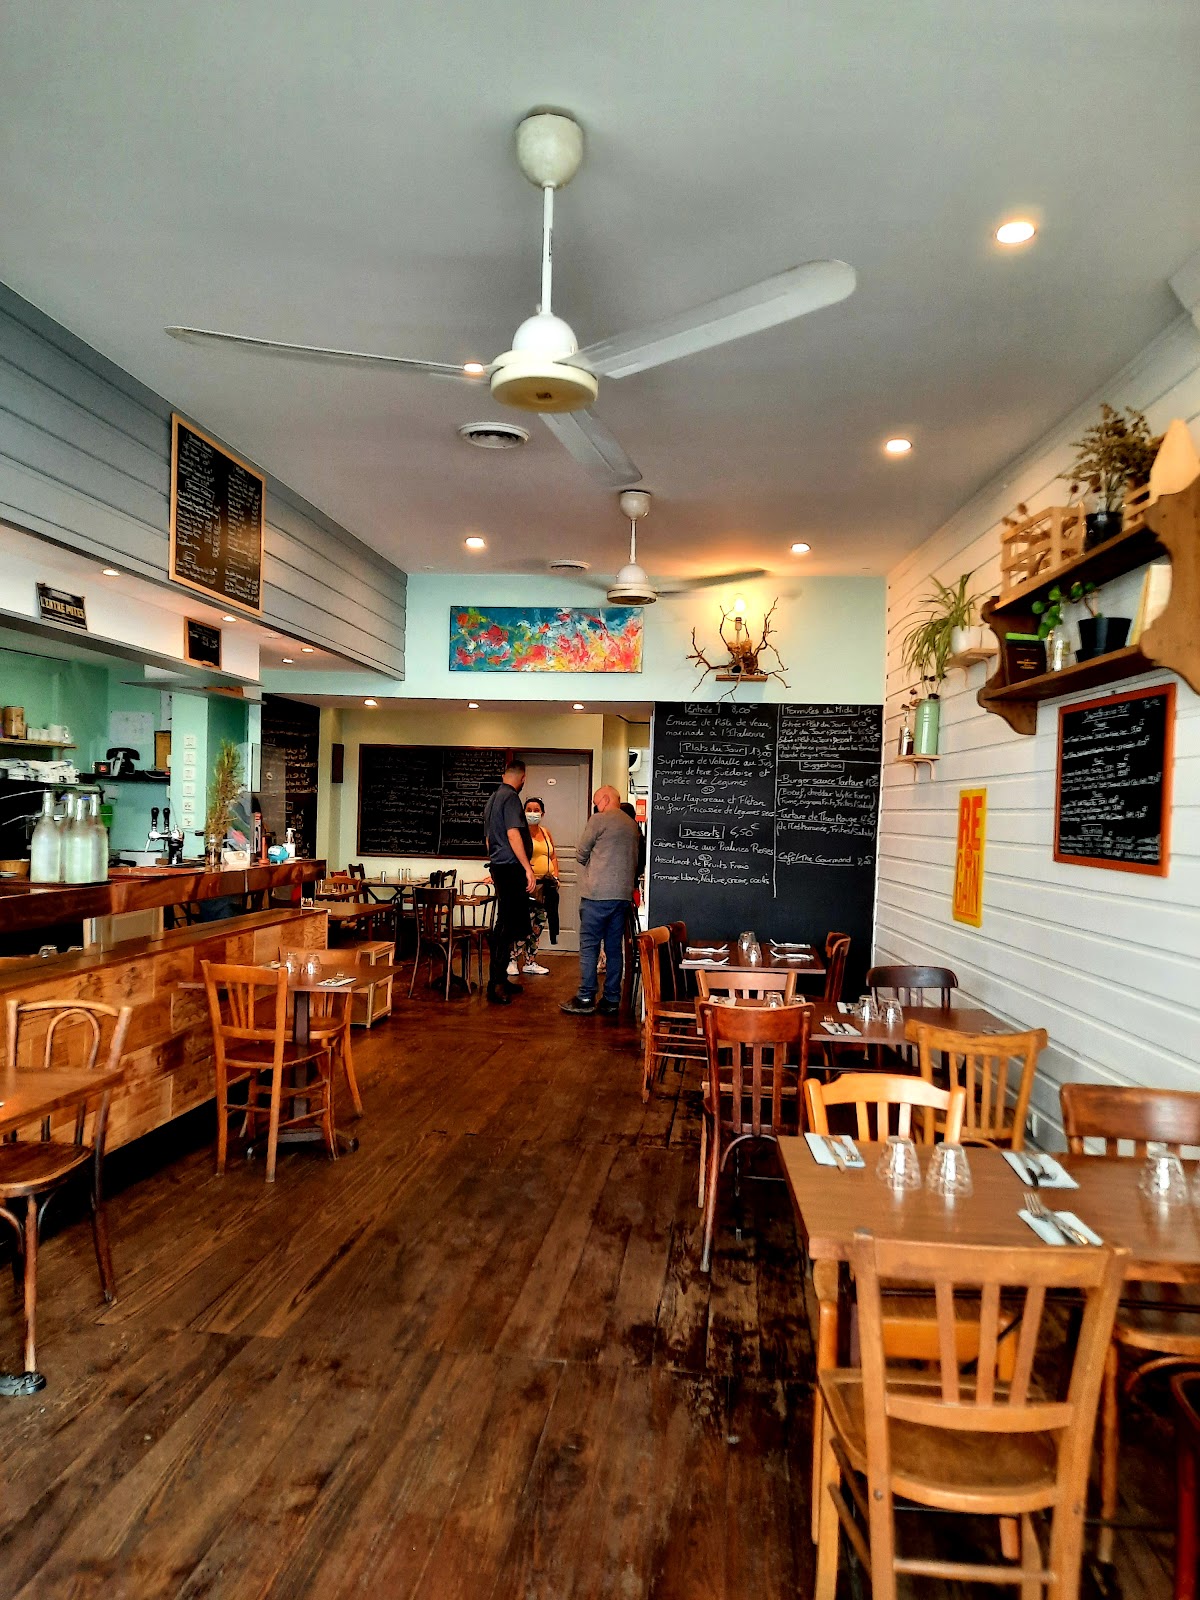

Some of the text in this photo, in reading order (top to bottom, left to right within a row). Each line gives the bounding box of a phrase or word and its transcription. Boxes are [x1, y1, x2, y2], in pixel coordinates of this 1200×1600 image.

[687, 704, 713, 714] Entrée
[785, 705, 819, 715] Formules
[835, 705, 853, 714] Midi
[700, 718, 710, 726] de
[736, 718, 746, 726] de
[666, 728, 704, 736] marinade
[709, 727, 717, 736] à
[682, 743, 708, 752] Plats
[710, 744, 722, 752] du
[722, 744, 745, 753] Jour
[657, 754, 694, 767] Suprême
[697, 756, 707, 765] de
[686, 767, 695, 775] de
[759, 768, 770, 777] et
[696, 777, 707, 785] de
[781, 774, 811, 787] Burger
[836, 775, 864, 786] Tartare
[654, 793, 670, 801] Duo
[671, 794, 681, 802] de
[727, 794, 737, 804] et
[654, 803, 665, 811] au
[724, 805, 733, 814] de
[808, 811, 818, 821] de
[836, 813, 857, 826] Rouge
[683, 825, 720, 838] Desserts
[701, 844, 716, 852] aux
[750, 842, 774, 856] Roses
[692, 858, 702, 867] de
[703, 860, 727, 869] Fruits
[815, 854, 852, 863] Gourmand
